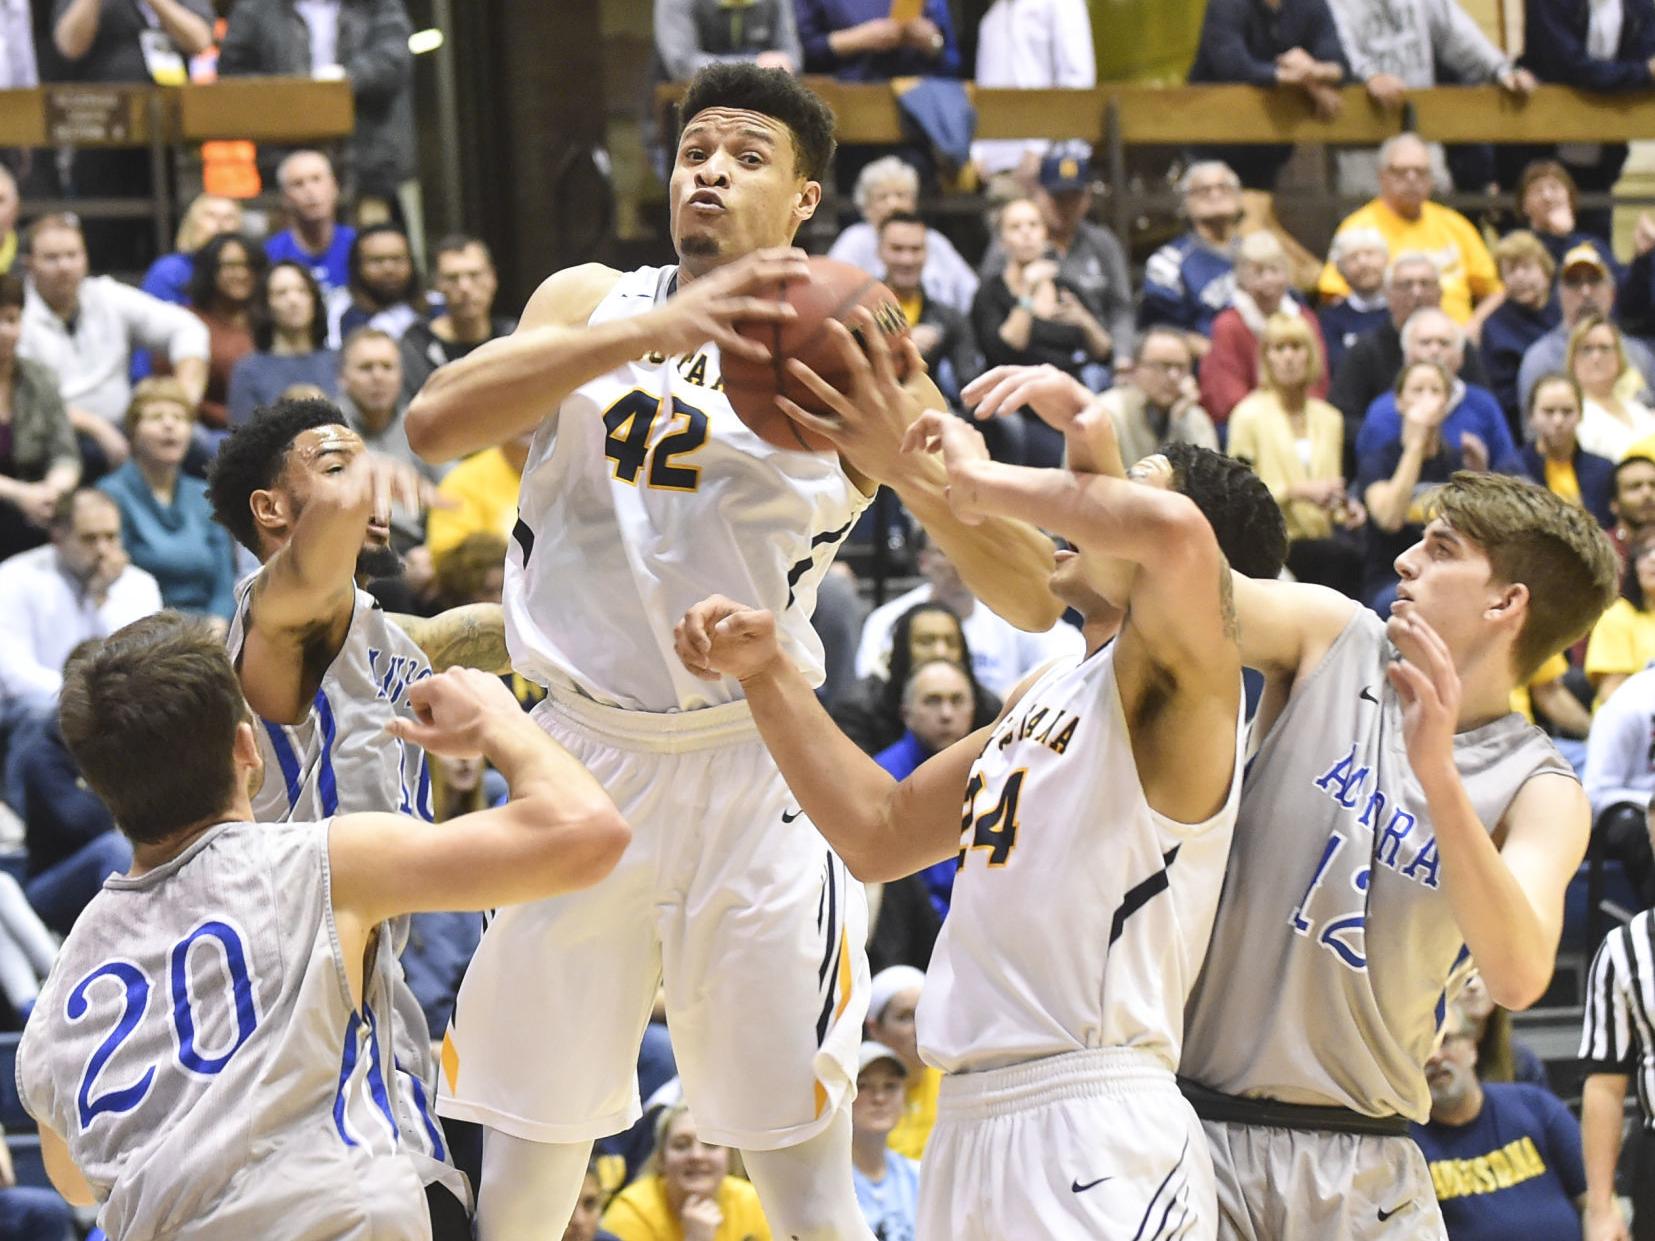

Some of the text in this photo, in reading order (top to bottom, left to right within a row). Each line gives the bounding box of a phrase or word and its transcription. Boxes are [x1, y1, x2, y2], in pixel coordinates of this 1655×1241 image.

[601, 386, 712, 494] 42
[1288, 830, 1371, 973] 12
[64, 914, 263, 1136] 20
